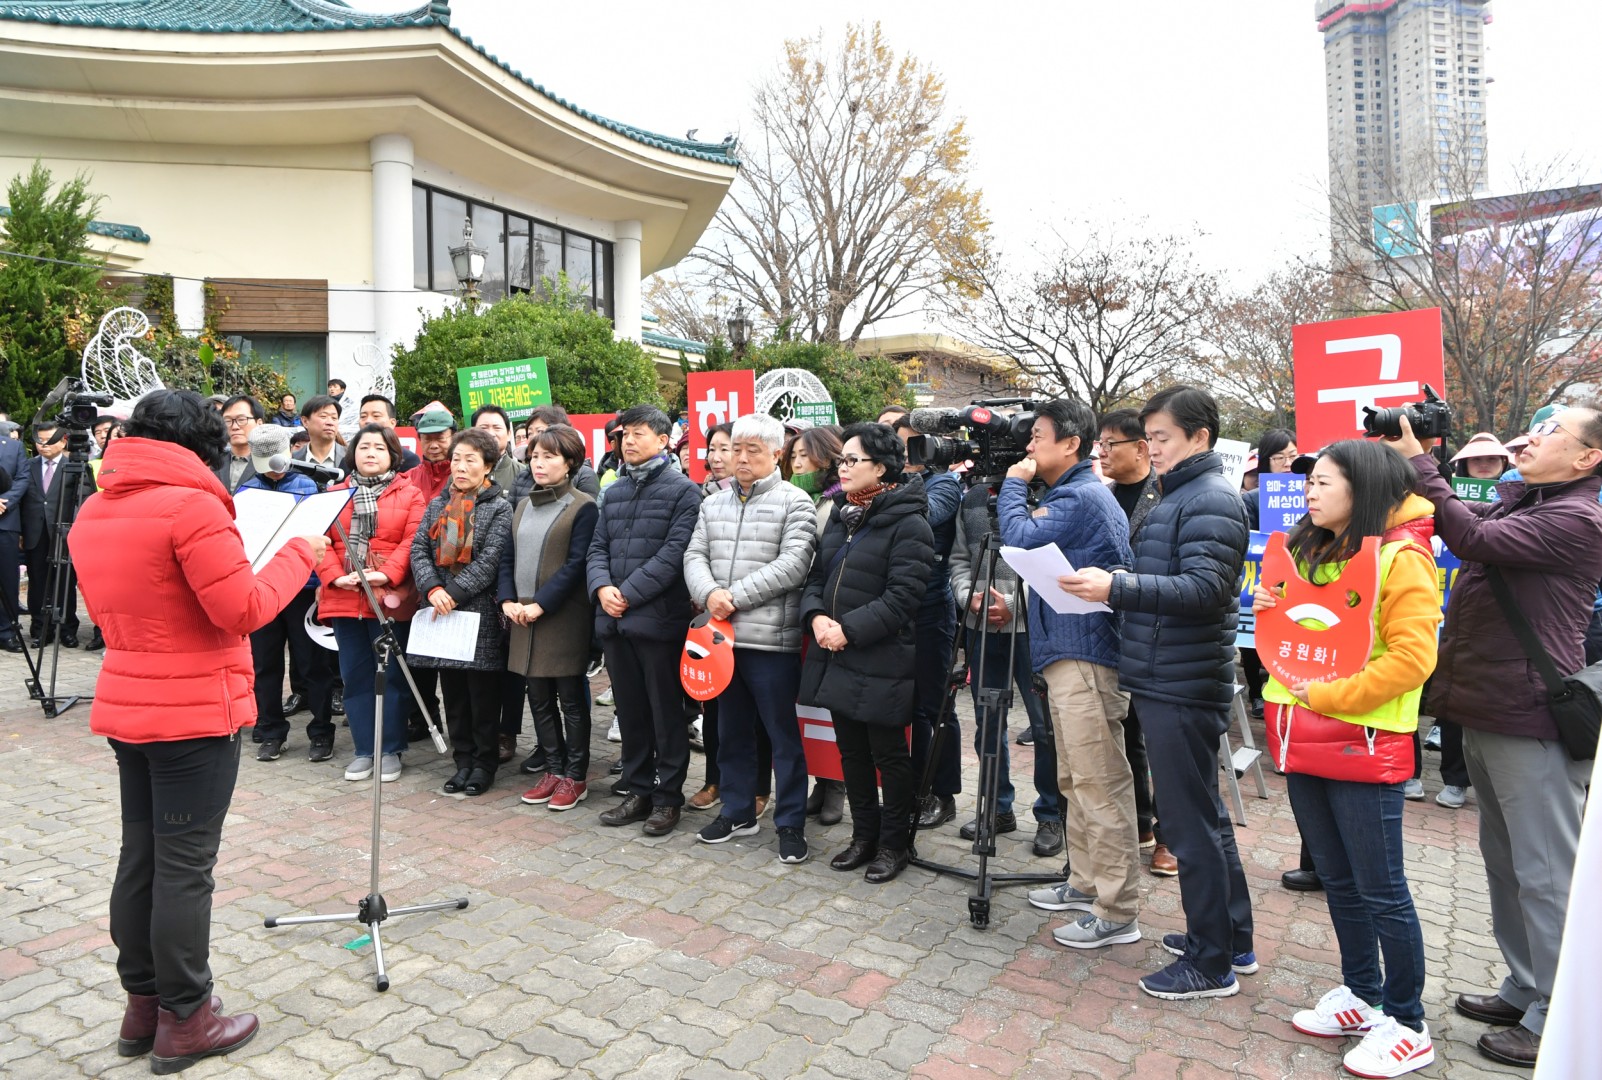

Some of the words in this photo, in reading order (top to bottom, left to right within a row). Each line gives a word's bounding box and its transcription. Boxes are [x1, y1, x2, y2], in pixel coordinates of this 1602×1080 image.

[1318, 334, 1419, 430] 구
[1266, 480, 1286, 492] 엄마~
[1456, 483, 1482, 498] 빌딩
